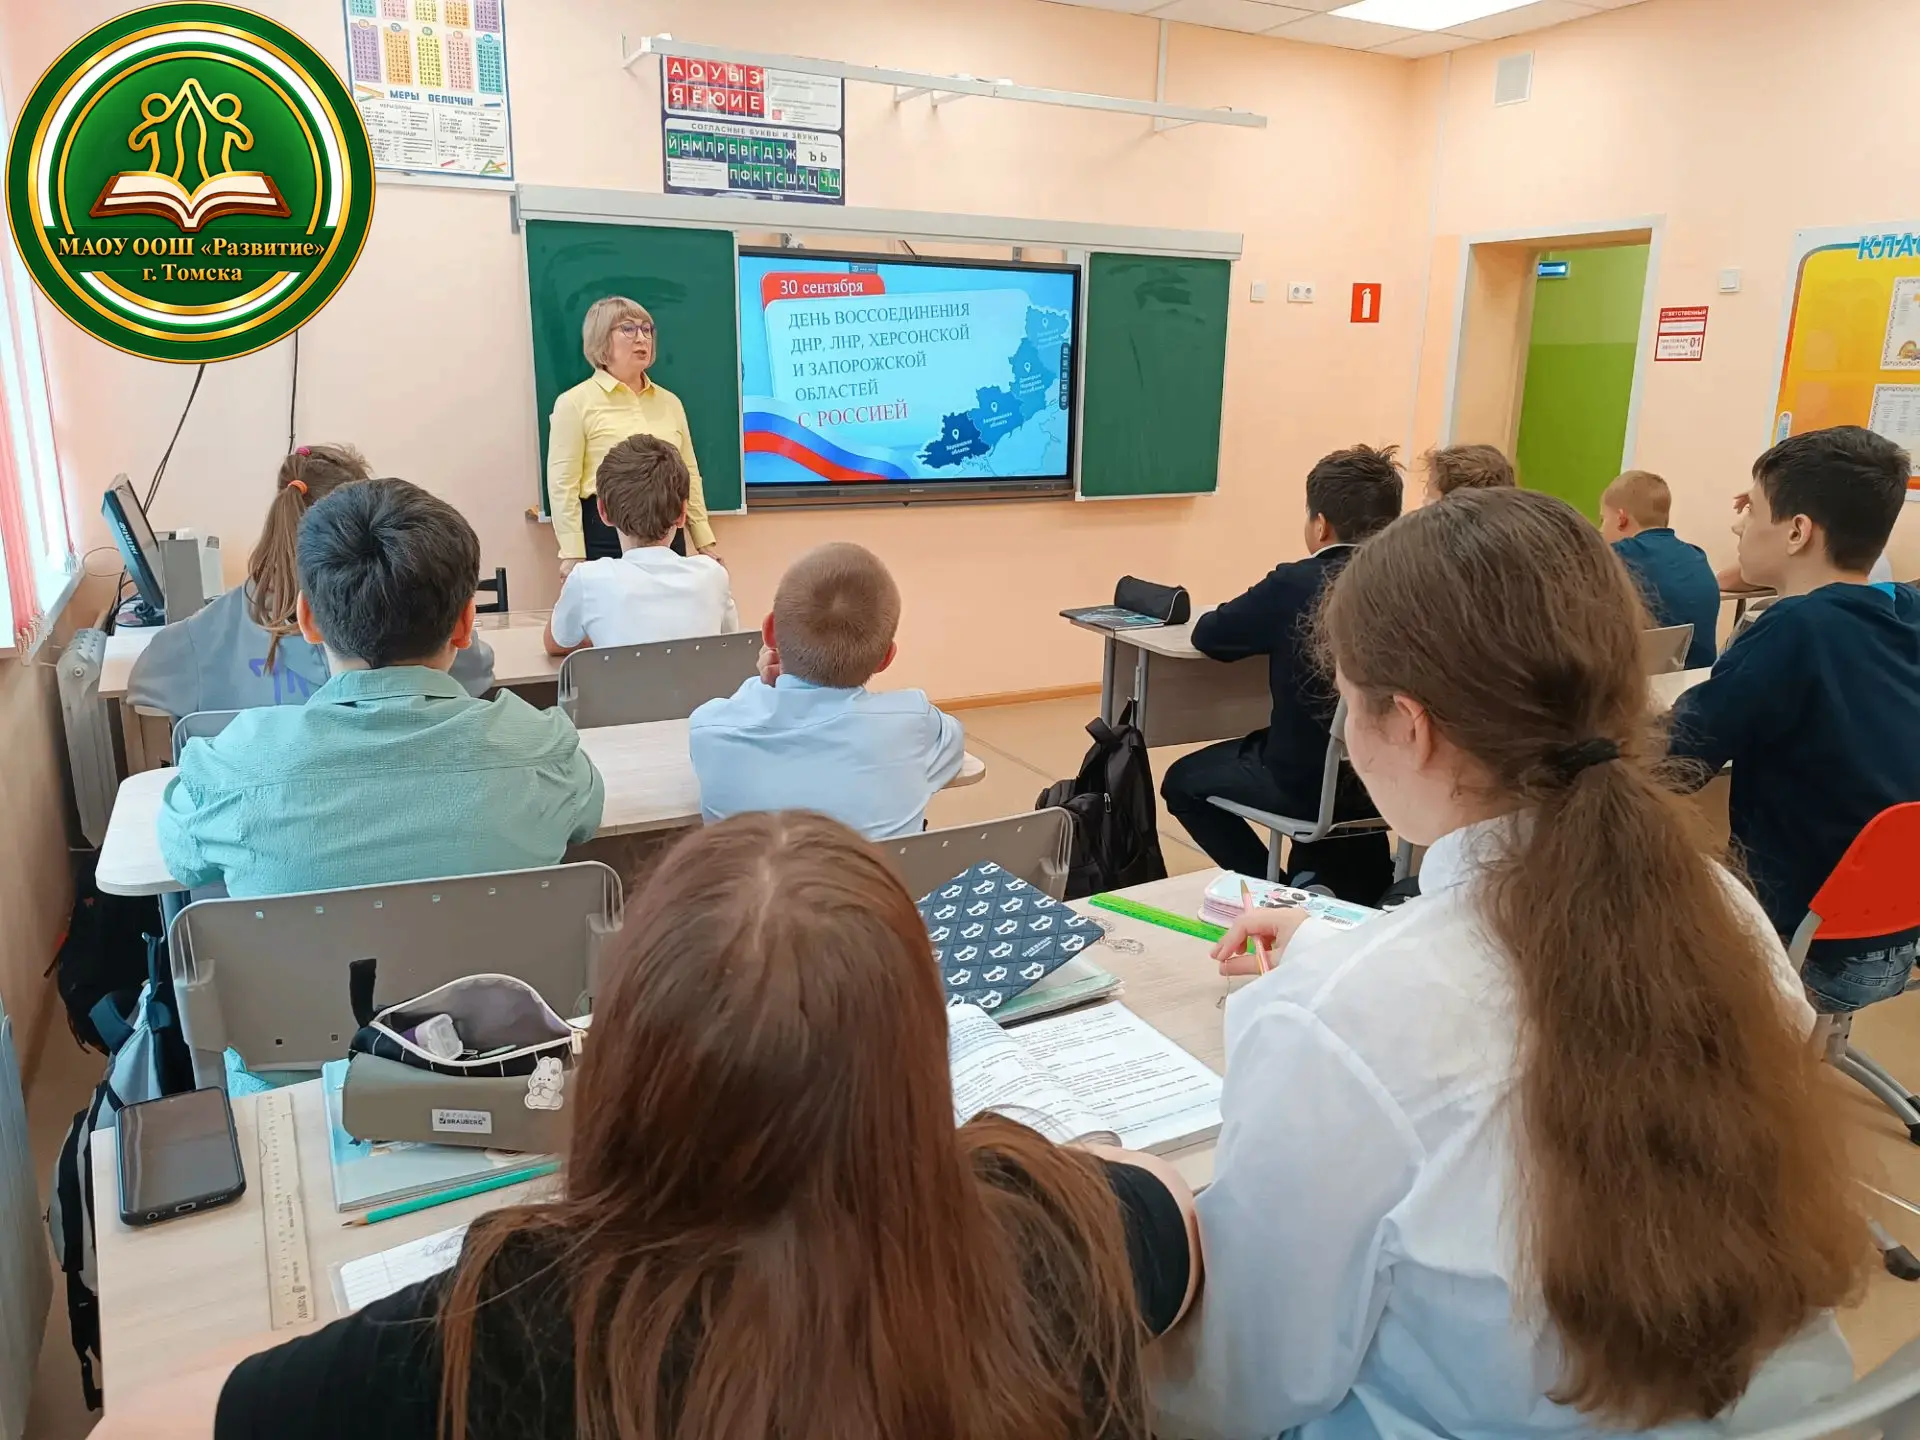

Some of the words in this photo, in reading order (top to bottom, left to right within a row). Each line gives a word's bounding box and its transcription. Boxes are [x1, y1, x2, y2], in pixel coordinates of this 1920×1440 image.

[671, 62, 683, 76] А
[690, 63, 703, 78] О
[711, 66, 722, 80] У
[729, 67, 743, 82] Ы
[749, 71, 761, 85] Э
[389, 90, 420, 101] МЕРЫ
[428, 94, 474, 106] ВЕЛИЧИН
[672, 88, 684, 102] Я
[693, 86, 703, 103] Ё
[708, 91, 725, 106] Ю
[731, 94, 742, 108] И
[750, 96, 760, 110] Е
[691, 123, 746, 135] СОГЛАСНЫЕ
[749, 128, 778, 137] БУКВЫ
[792, 133, 819, 141] ЗВУКИ
[809, 151, 817, 162] Ъ
[820, 152, 828, 162] Ь
[780, 279, 798, 295] 30
[802, 278, 864, 297] сентября
[788, 312, 831, 330] ДЕНЬ
[835, 303, 970, 325] ВОССОЕДИНЕНИЯ
[790, 336, 826, 355] ДНР,
[830, 334, 864, 351] ЛНР,
[868, 323, 970, 347] ХЕРСОНСКОЙ
[1689, 337, 1701, 348] 01
[792, 363, 804, 377] И
[808, 350, 928, 376] ЗАПОРОЖСКОЙ
[795, 378, 879, 401] ОБЛАСТЕЙ
[798, 412, 811, 428] С
[818, 398, 908, 427] РОССИЕЙ
